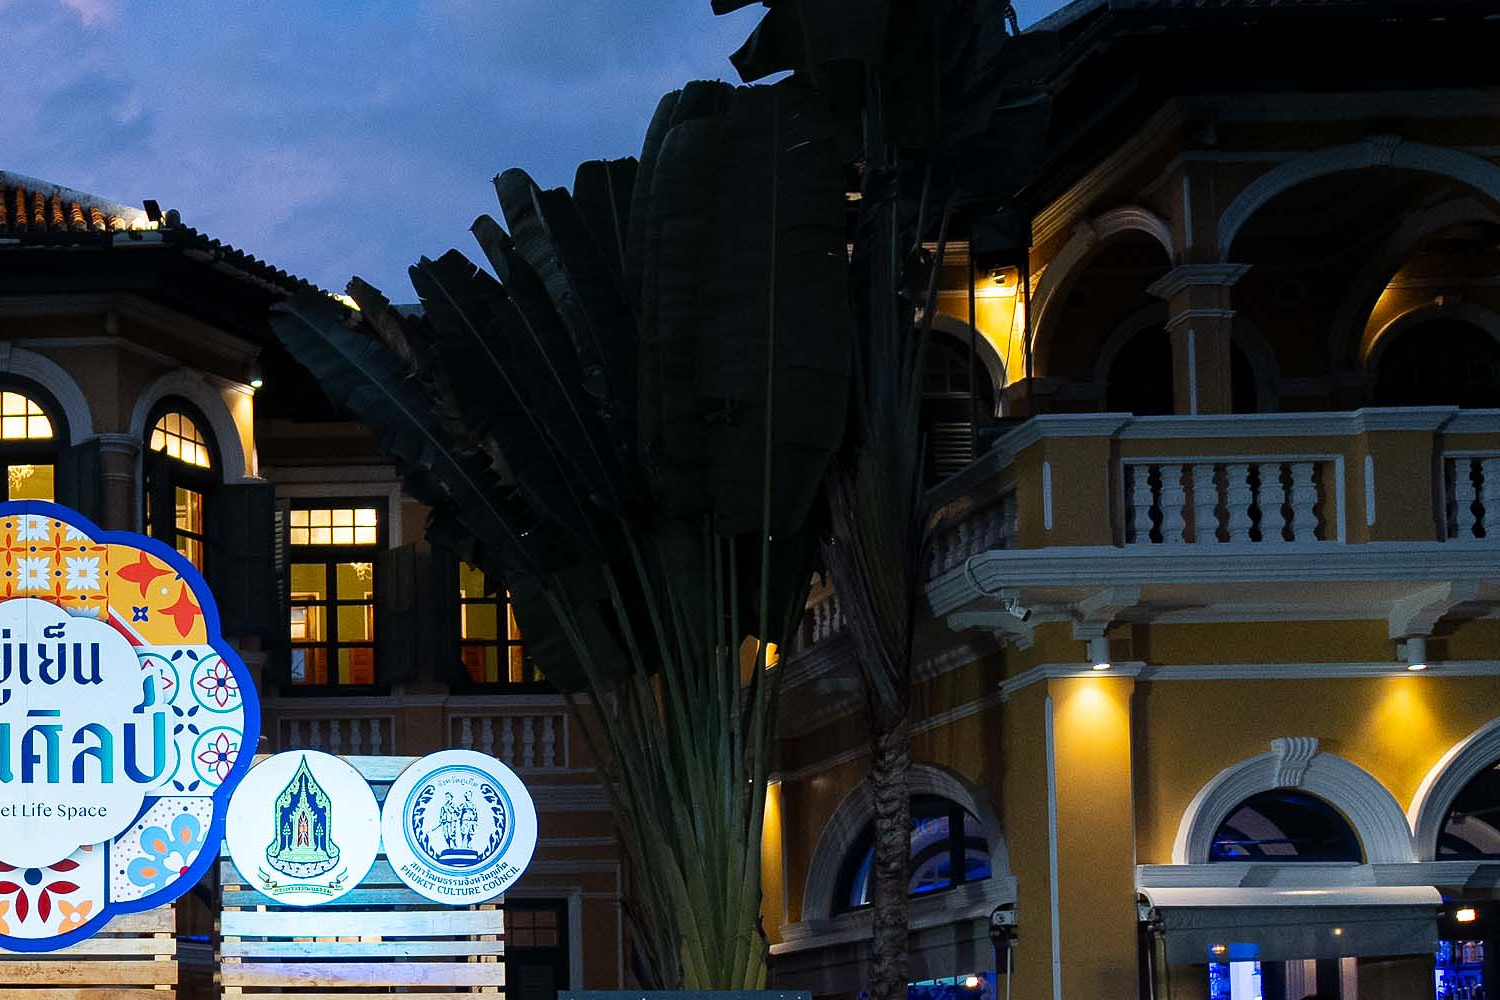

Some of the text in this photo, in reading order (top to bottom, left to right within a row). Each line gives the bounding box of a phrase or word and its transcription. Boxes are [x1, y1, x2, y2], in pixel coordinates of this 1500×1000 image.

[22, 803, 52, 818] Life
[57, 803, 108, 822] Space
[401, 865, 520, 896] PHUKET CULTURE COUNCIL
